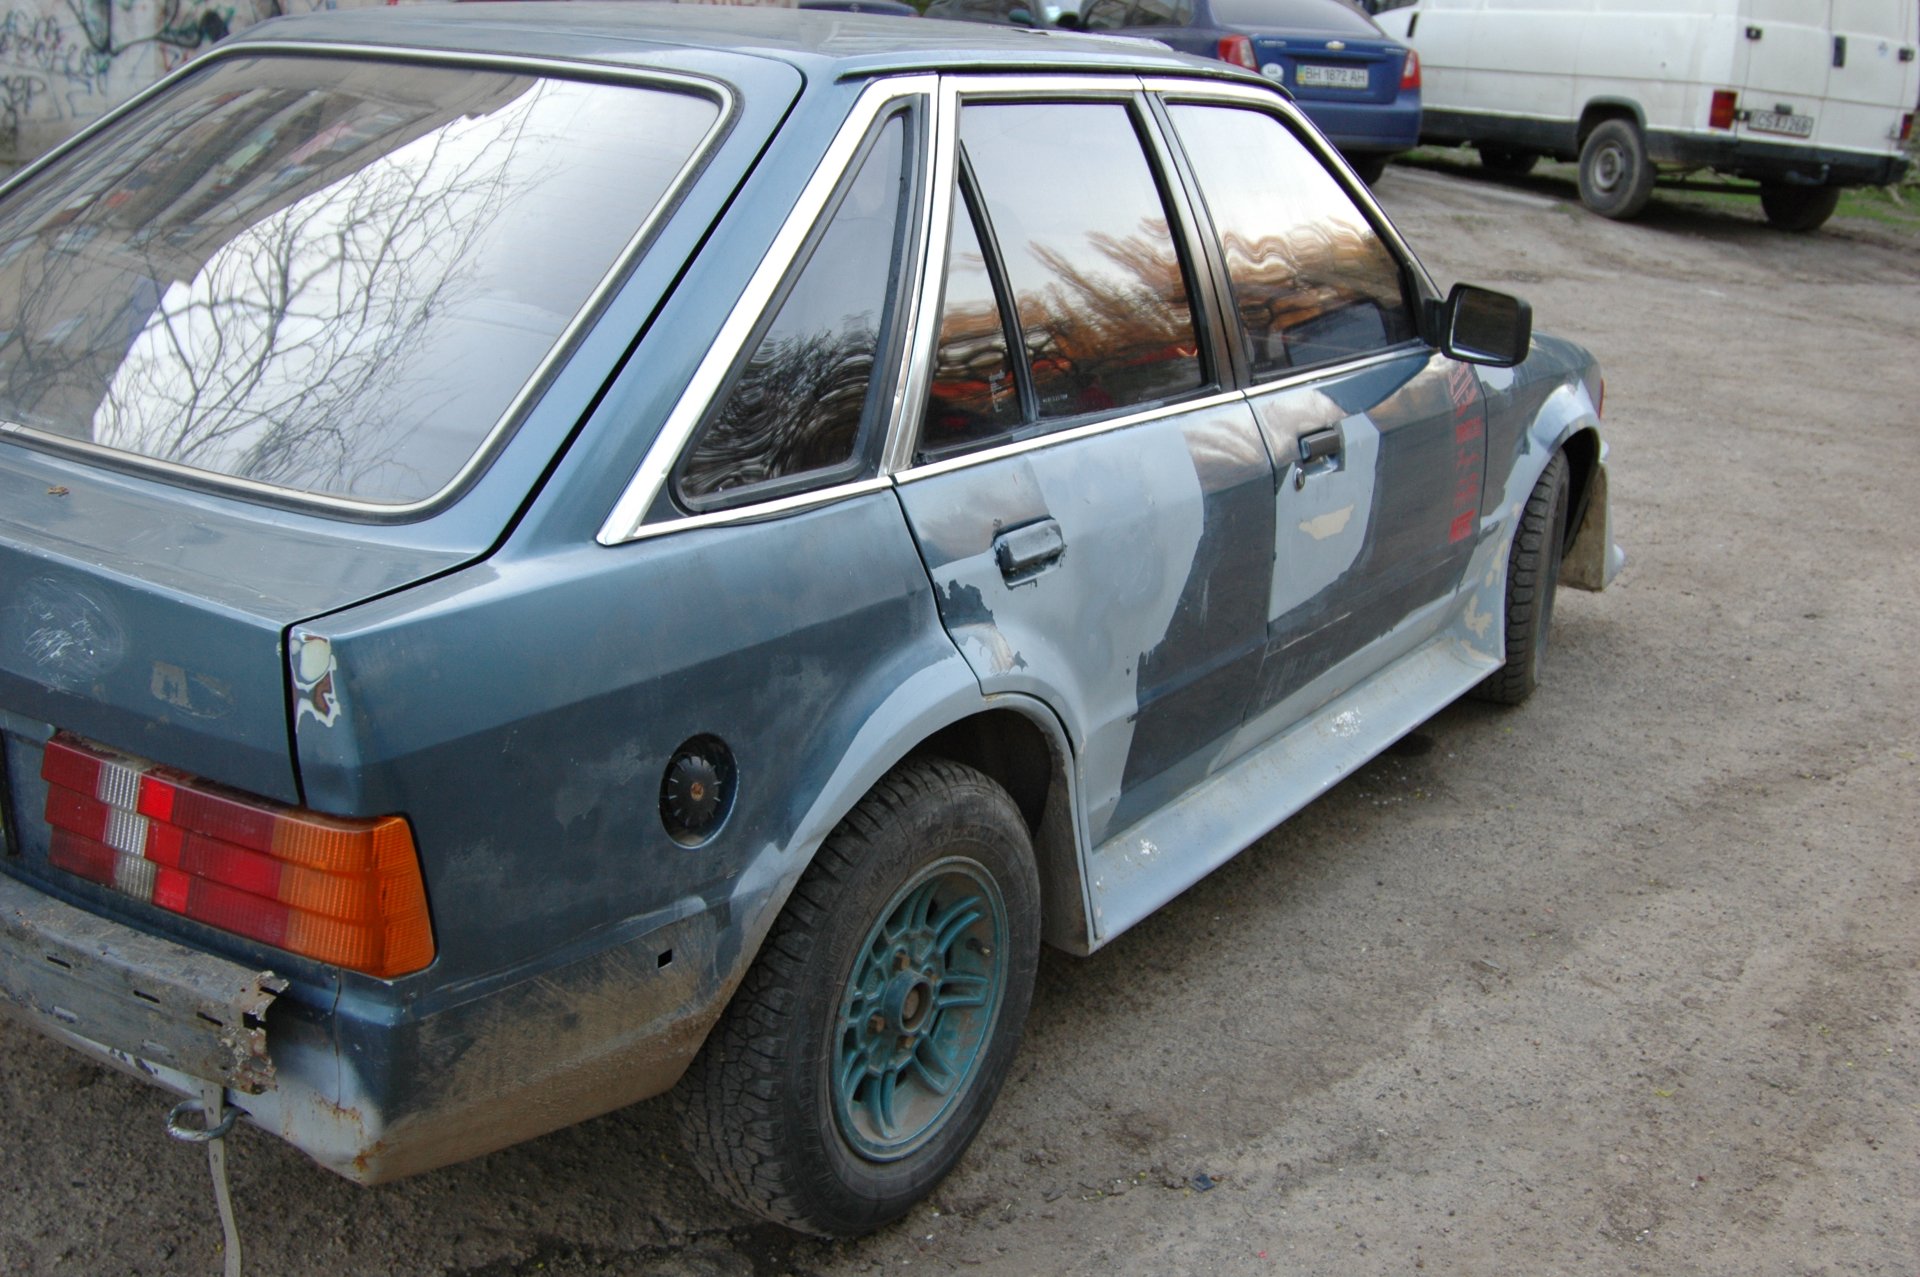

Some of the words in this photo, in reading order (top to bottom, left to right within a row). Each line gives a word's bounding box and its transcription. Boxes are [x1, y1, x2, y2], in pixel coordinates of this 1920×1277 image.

[1305, 66, 1320, 79] BH
[1324, 67, 1347, 81] 1872
[1350, 68, 1366, 82] AH
